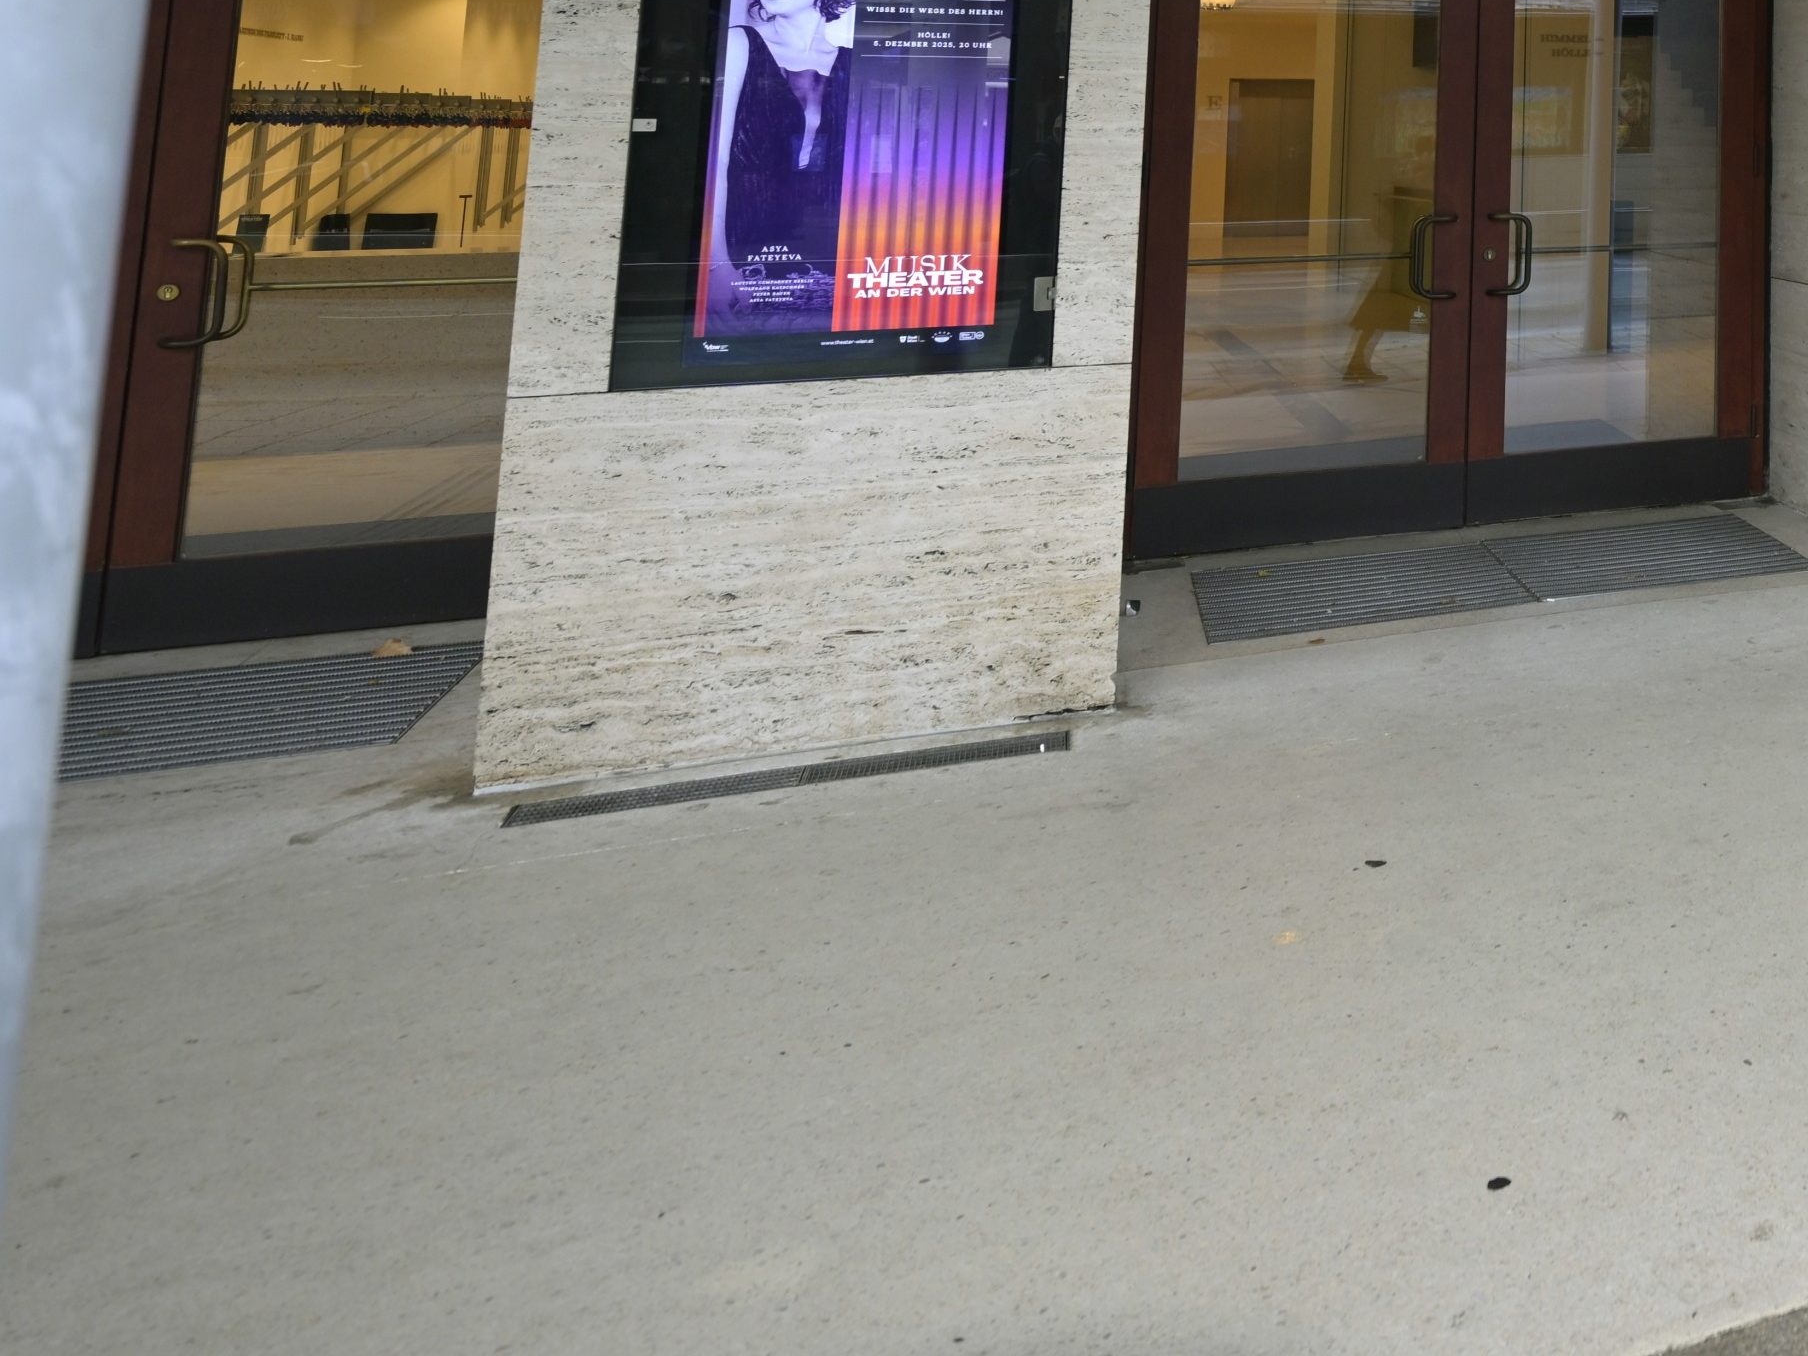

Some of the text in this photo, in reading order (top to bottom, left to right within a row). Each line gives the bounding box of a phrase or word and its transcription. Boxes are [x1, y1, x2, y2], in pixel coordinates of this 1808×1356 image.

[918, 31, 951, 39] HÖLLE!
[761, 245, 789, 253] ASYA
[747, 253, 802, 262] FATEYEVA
[864, 254, 972, 277] MUSIK
[847, 269, 984, 289] THEATER
[855, 286, 975, 299] AN DER WIEN
